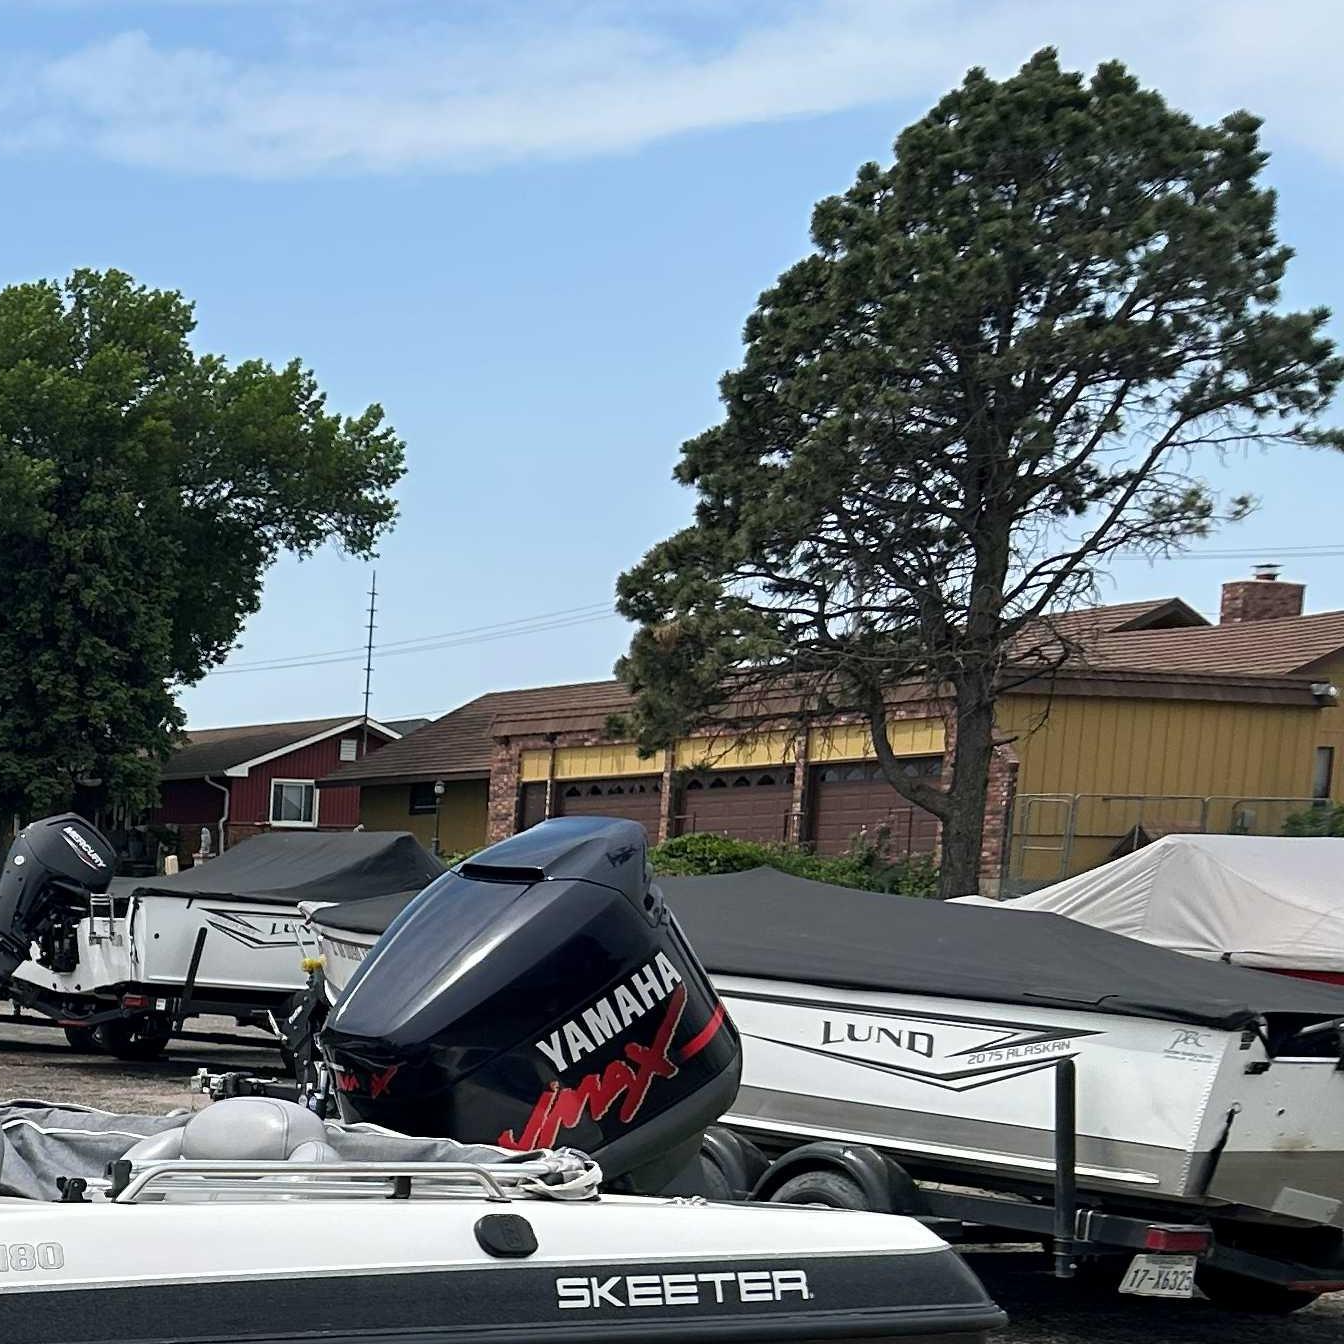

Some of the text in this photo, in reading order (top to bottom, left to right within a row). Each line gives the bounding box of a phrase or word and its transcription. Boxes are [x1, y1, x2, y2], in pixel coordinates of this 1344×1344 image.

[62, 826, 107, 867] MERCURY
[269, 922, 312, 936] LUN
[535, 950, 682, 1073] YAMAHA
[820, 1020, 934, 1058] LUND
[967, 1040, 1071, 1065] 2075 ALASKAN
[556, 1269, 810, 1309] SKEETER
